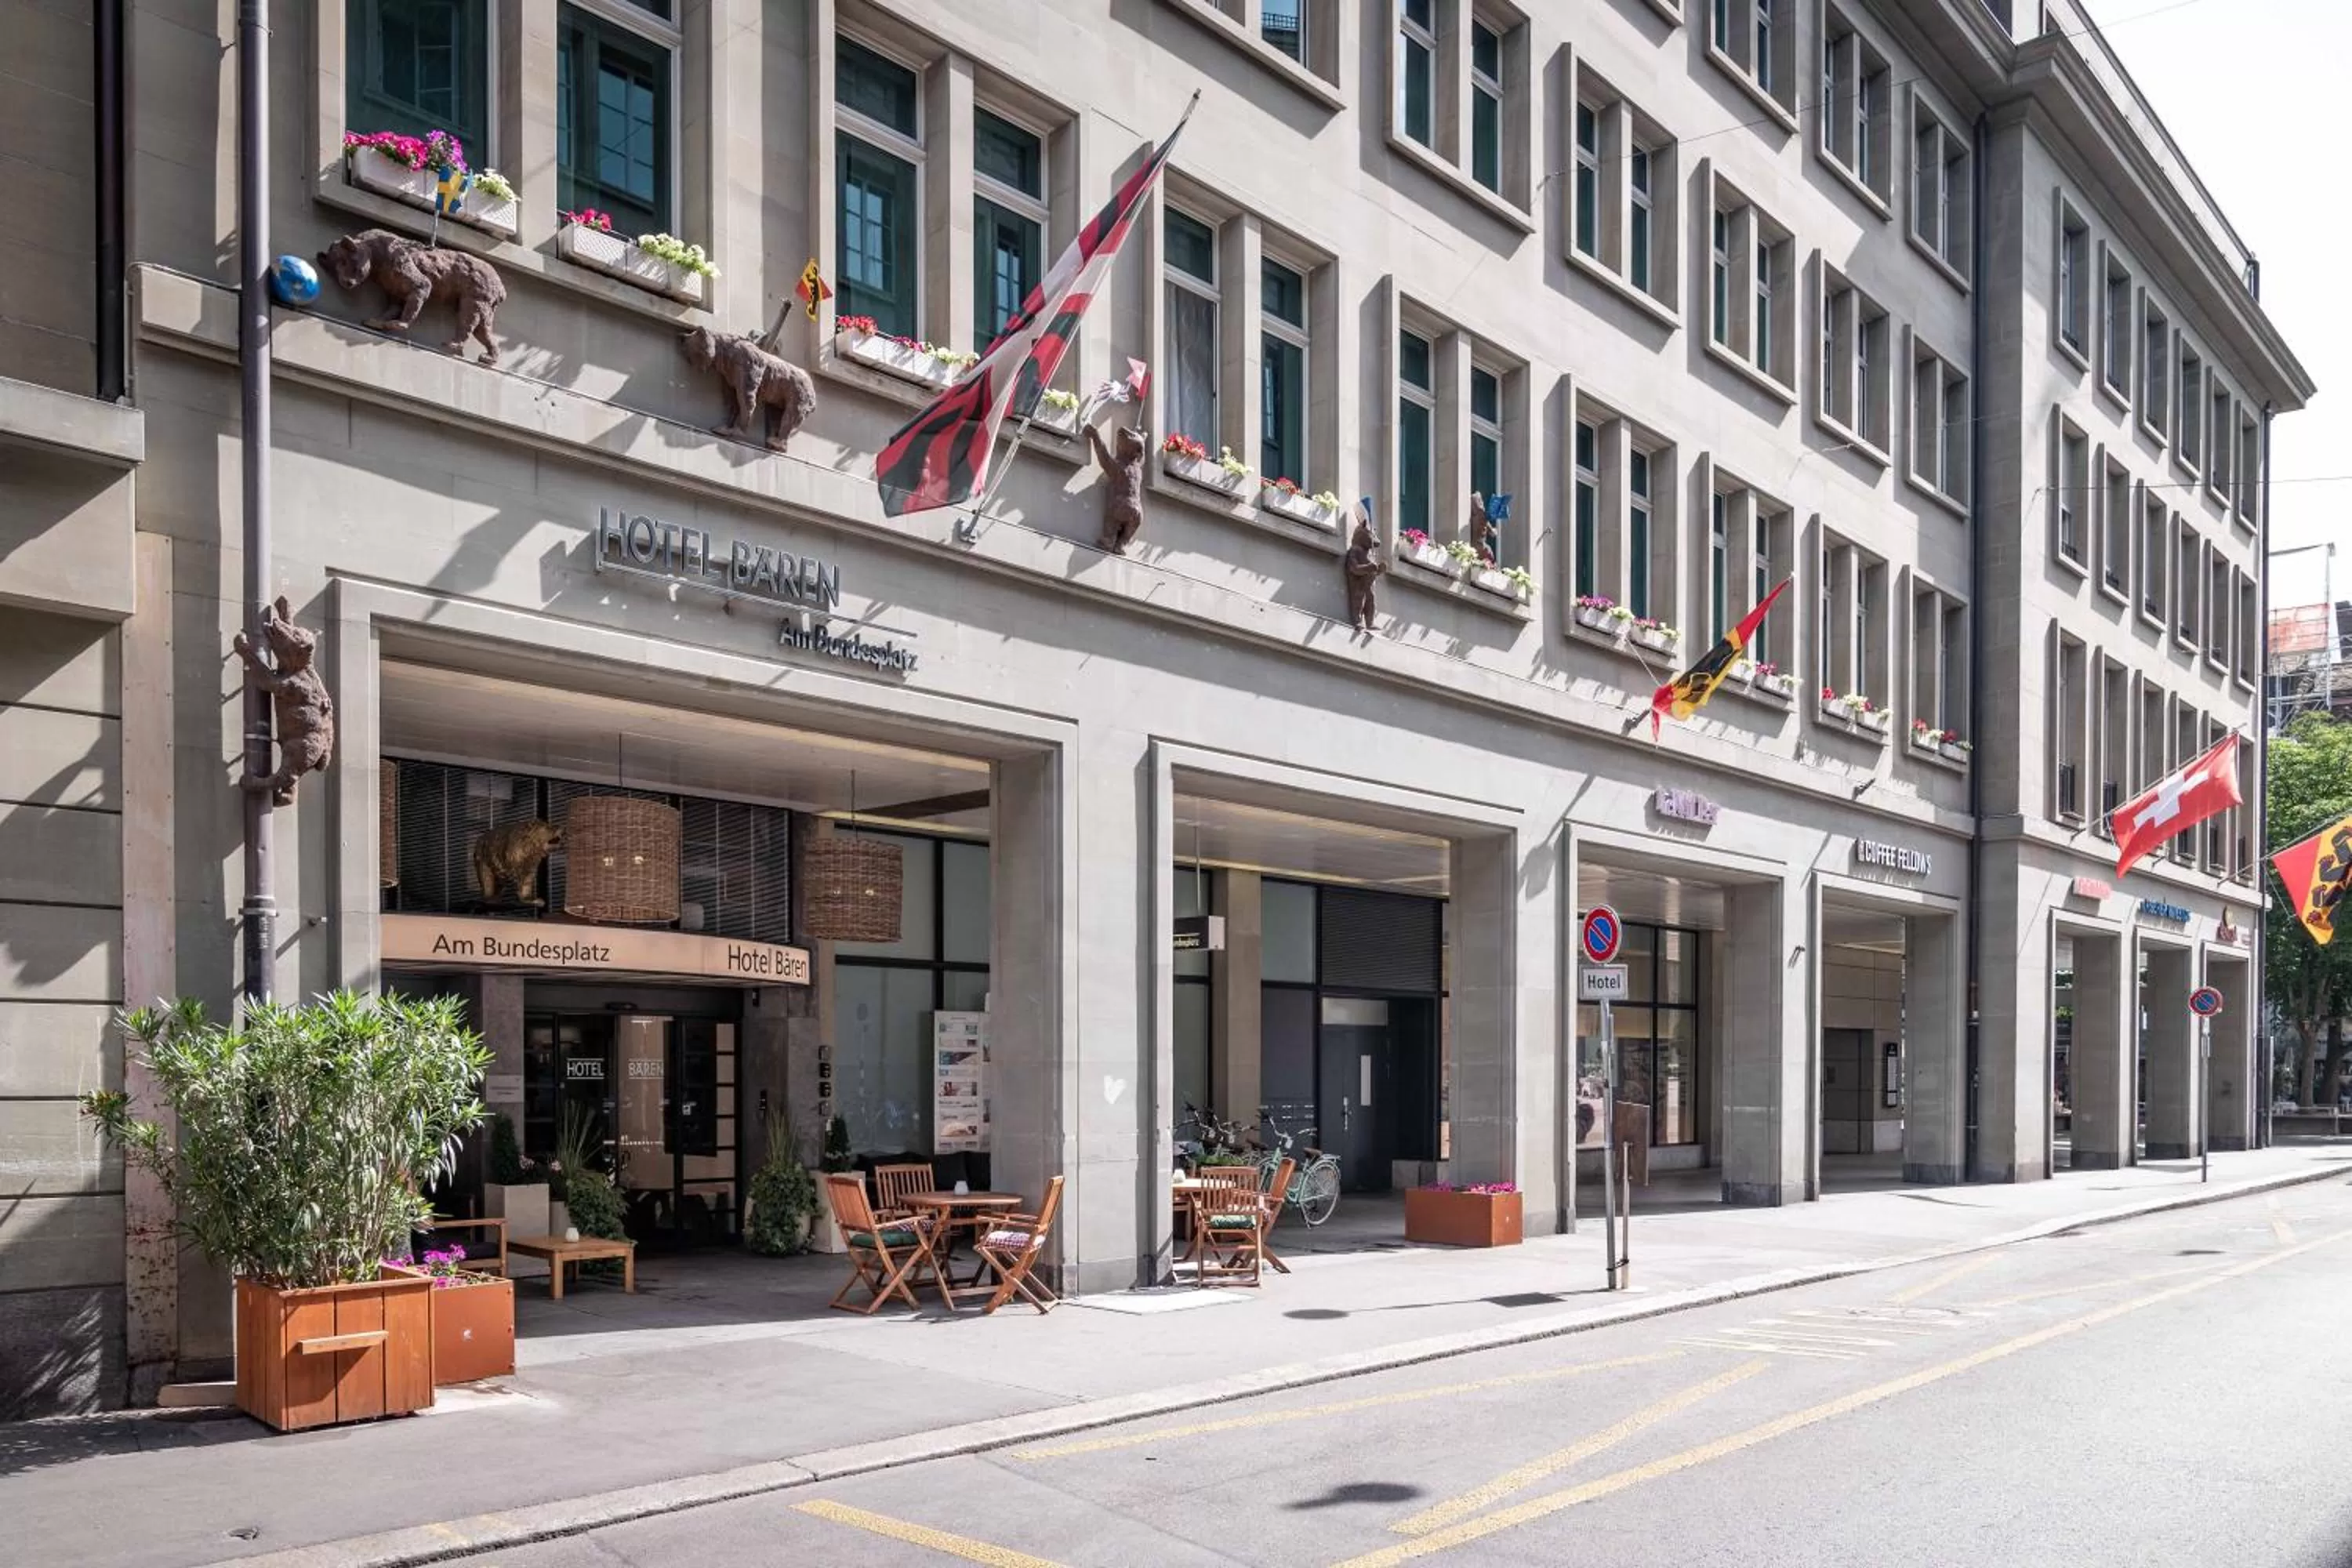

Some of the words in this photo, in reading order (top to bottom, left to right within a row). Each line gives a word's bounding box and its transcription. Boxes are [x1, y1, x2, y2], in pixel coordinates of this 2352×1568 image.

[599, 505, 721, 577] HOTEL
[731, 539, 840, 608] BÄREN
[779, 617, 812, 650] Am
[815, 624, 918, 672] Bundesplatz
[1865, 840, 1896, 867] COFFEE
[432, 934, 474, 956] Am
[483, 937, 610, 965] Bundesplatz
[728, 945, 772, 975] Hotel
[775, 952, 808, 978] Bären
[1588, 975, 1621, 989] Hotel
[566, 1062, 604, 1076] HOTEL
[628, 1062, 664, 1076] BÄREN
